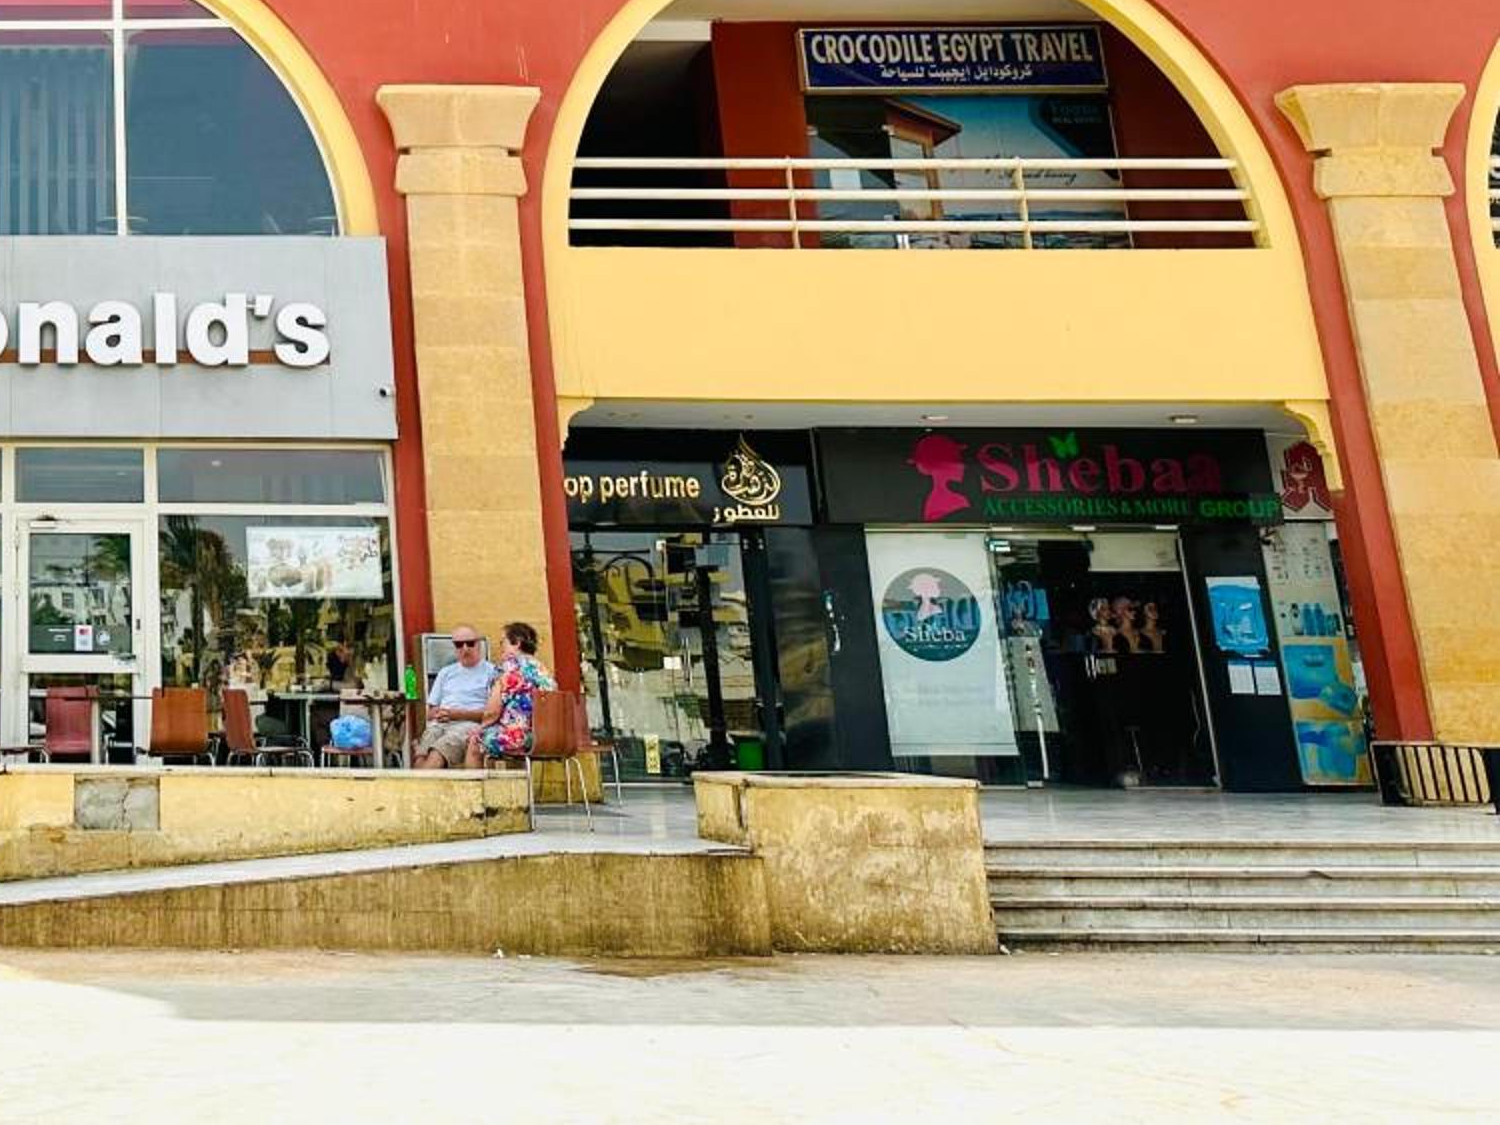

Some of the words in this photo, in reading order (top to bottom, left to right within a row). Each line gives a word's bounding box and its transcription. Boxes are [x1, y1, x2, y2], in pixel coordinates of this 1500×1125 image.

[811, 34, 935, 64] CROCODILE
[938, 33, 1004, 63] EGYPT
[1011, 32, 1093, 63] TRAVEL
[599, 469, 700, 504] perfume
[982, 496, 1120, 518] ACCESSORIES
[1198, 499, 1280, 519] GROUP
